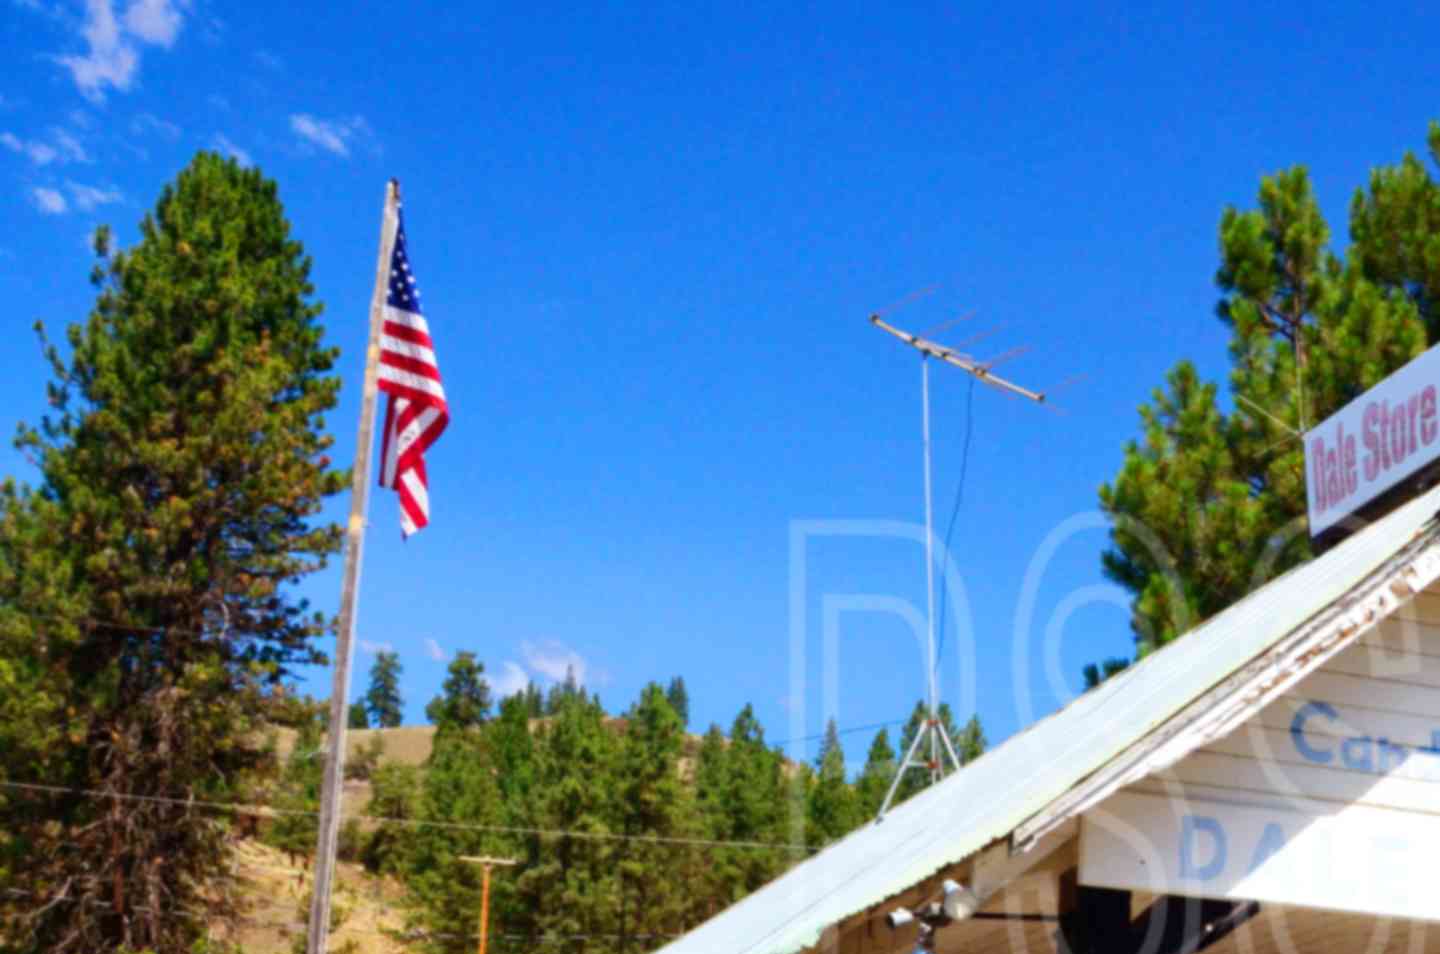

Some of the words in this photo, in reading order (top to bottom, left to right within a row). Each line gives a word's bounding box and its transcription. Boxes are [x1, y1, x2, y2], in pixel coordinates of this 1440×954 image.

[1310, 422, 1358, 513] Dale
[1362, 384, 1439, 482] Store
[1178, 814, 1411, 901] DALE
